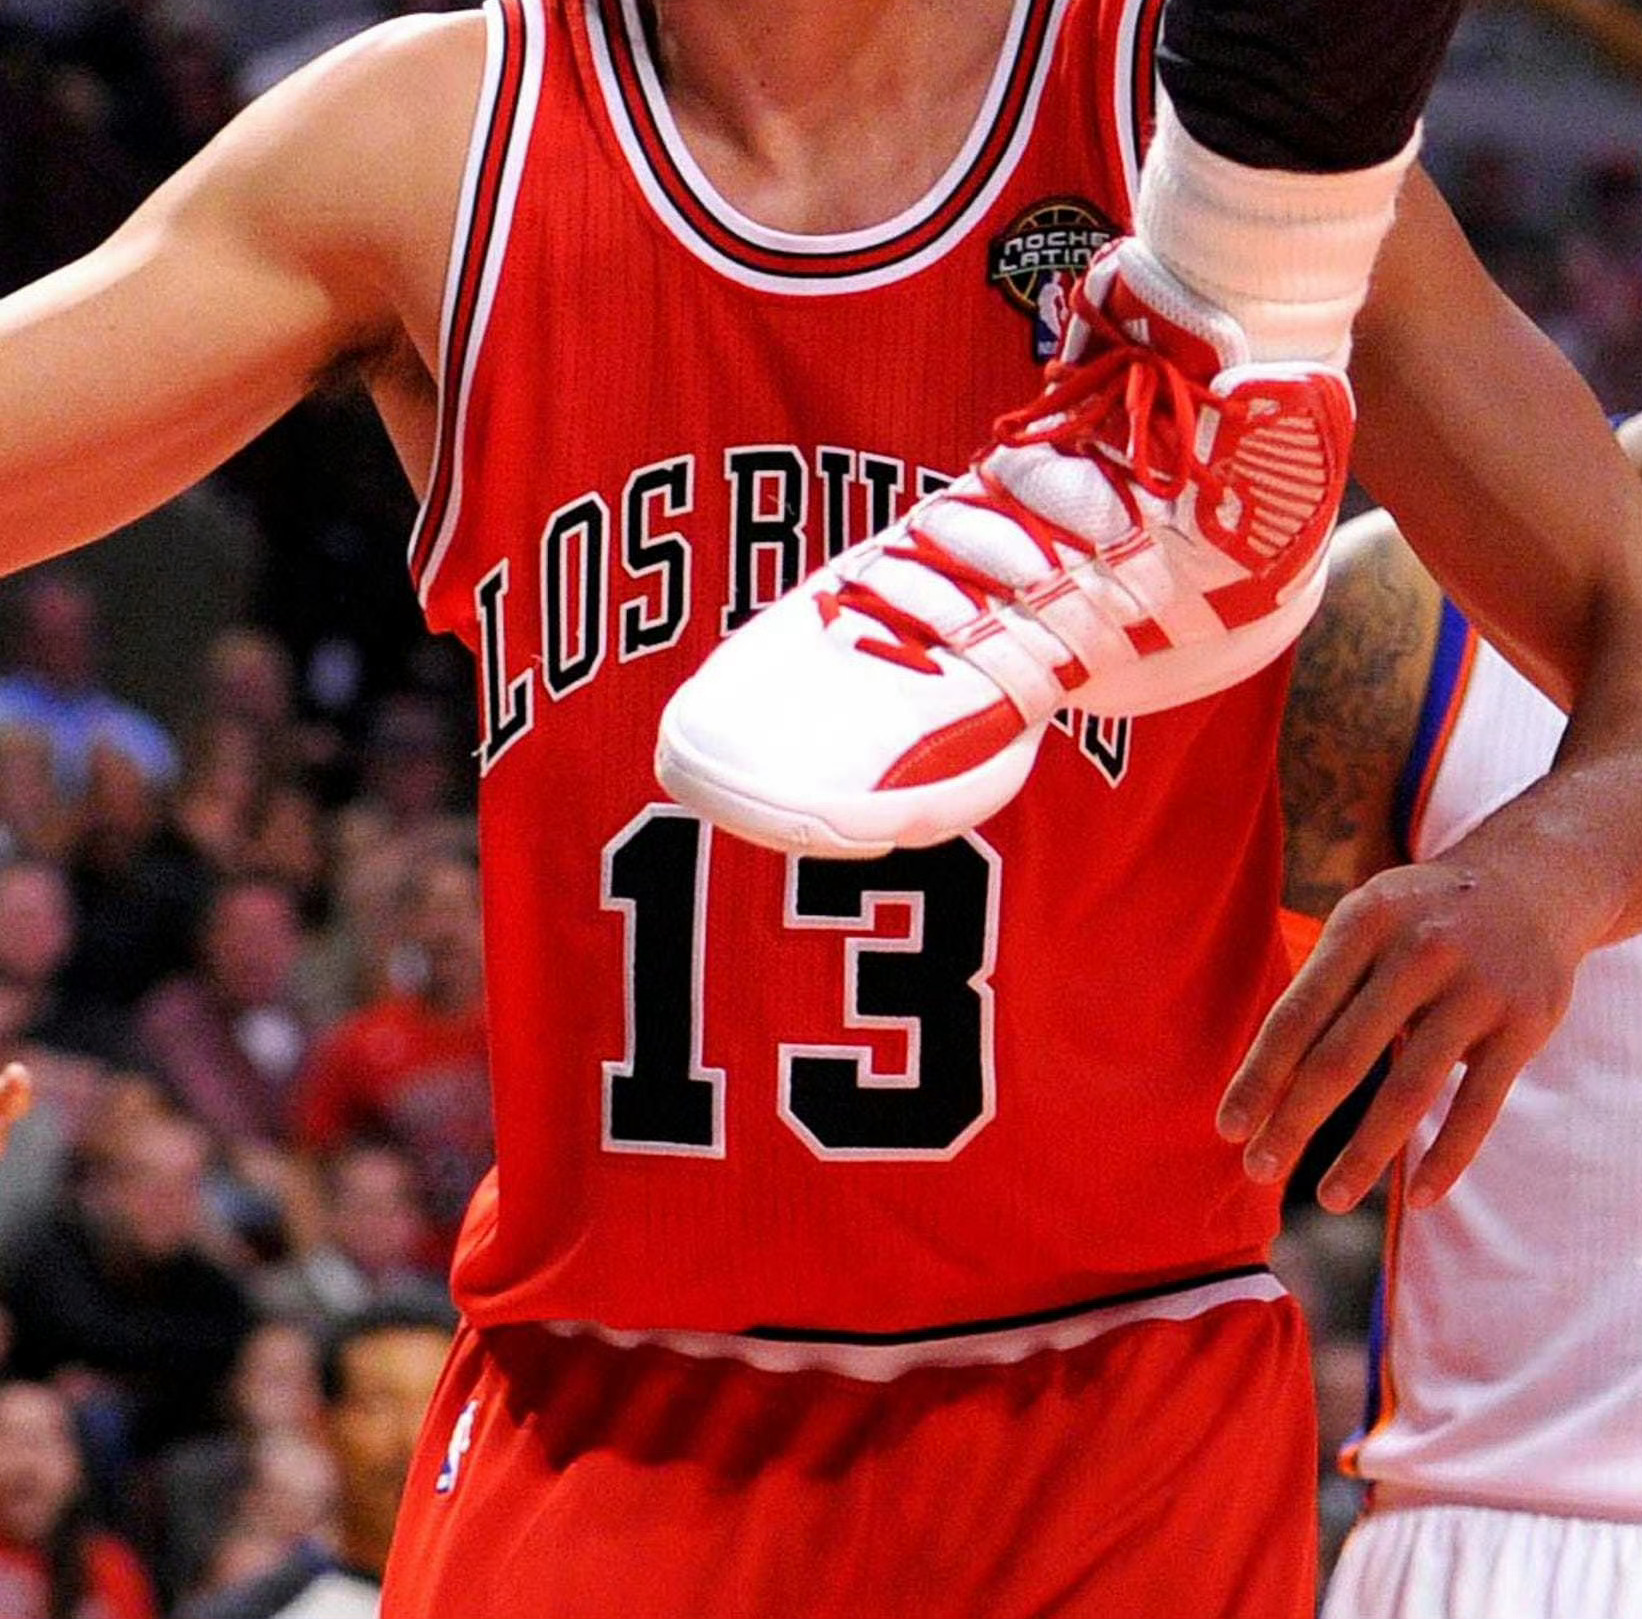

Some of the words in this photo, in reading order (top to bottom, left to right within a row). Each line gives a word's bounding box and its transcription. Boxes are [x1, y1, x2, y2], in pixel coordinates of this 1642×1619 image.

[998, 248, 1093, 273] LATIN
[1003, 230, 1111, 257] NOCHE
[472, 453, 696, 779] LOS
[600, 800, 1003, 1162] 13
